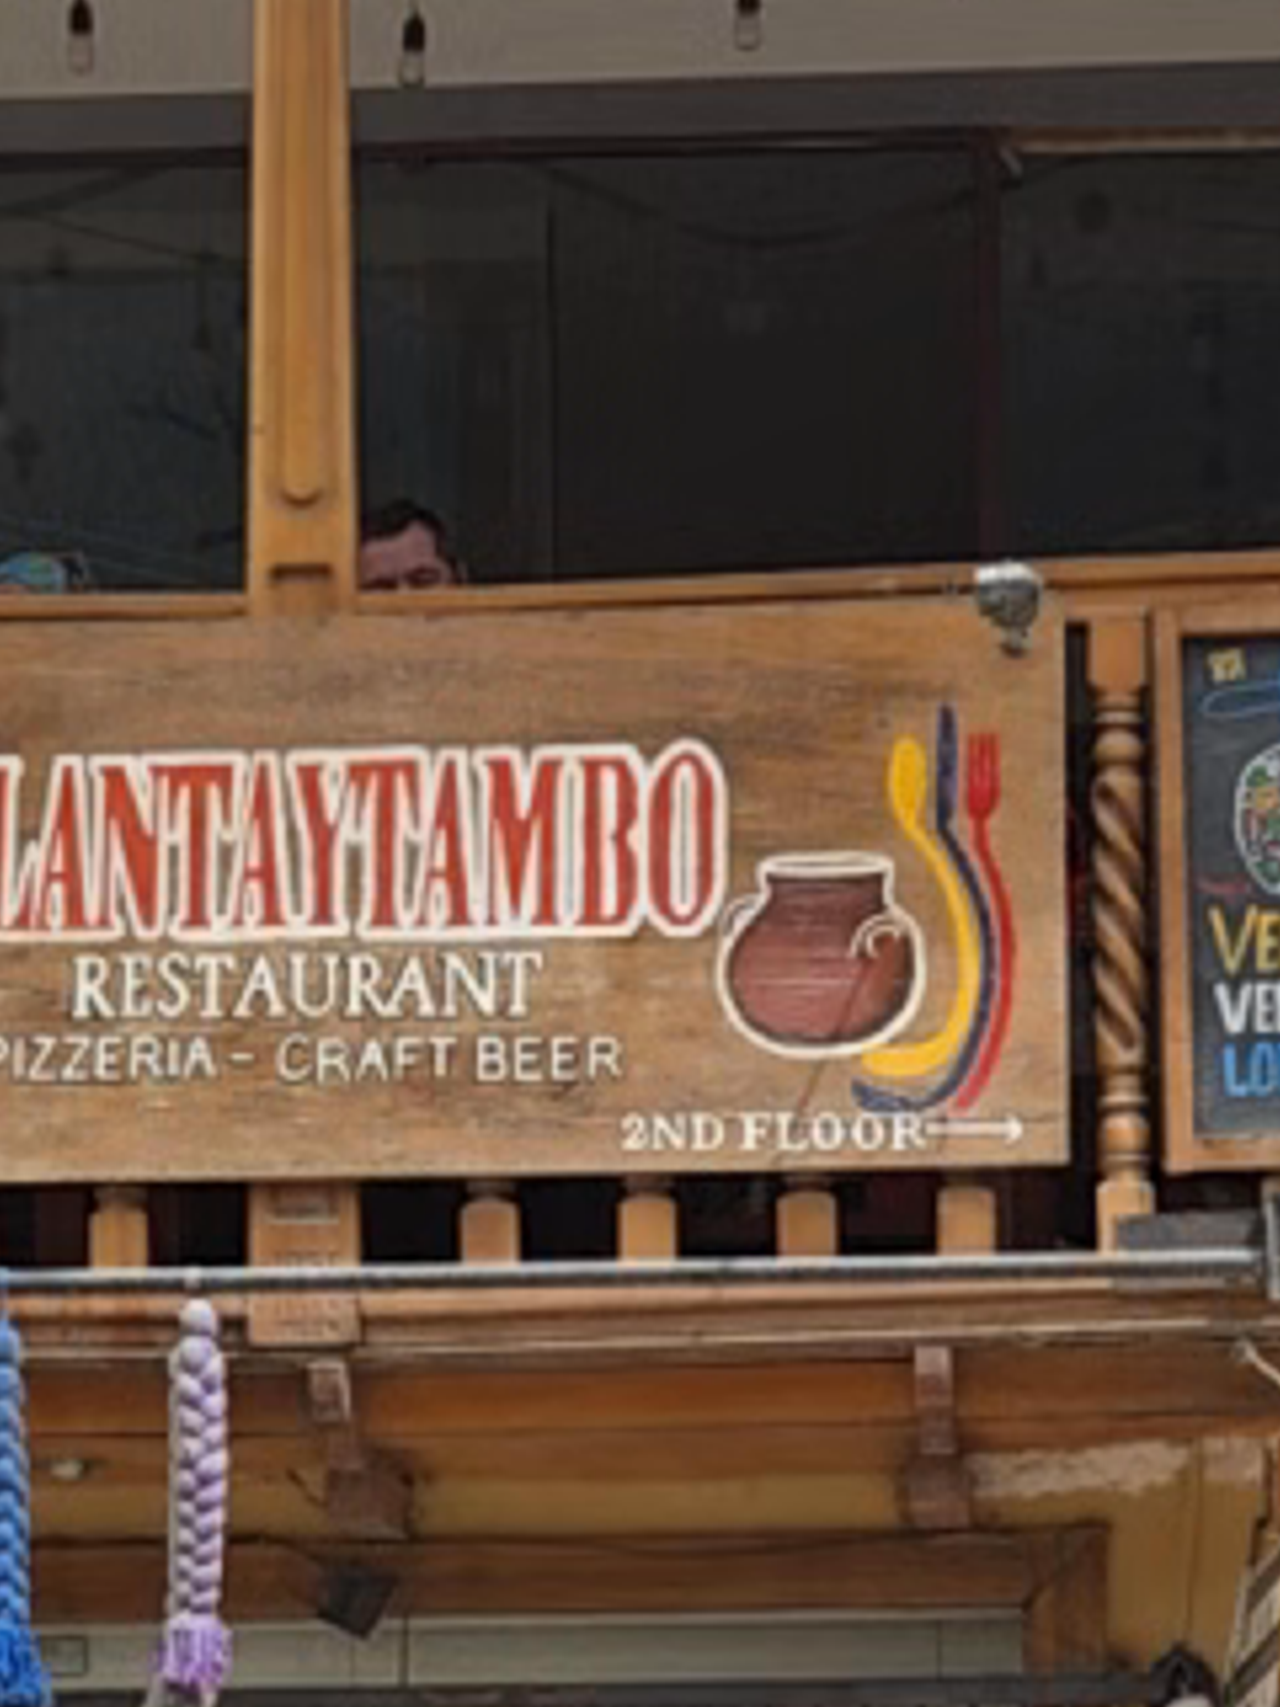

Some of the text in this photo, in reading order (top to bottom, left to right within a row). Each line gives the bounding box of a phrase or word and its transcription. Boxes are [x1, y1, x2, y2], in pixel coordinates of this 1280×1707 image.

[71, 949, 543, 1019] RESTAURANT
[276, 1034, 459, 1082] CRAFT
[475, 1034, 623, 1081] BEER
[620, 1108, 927, 1152] 2ND FLOOR
